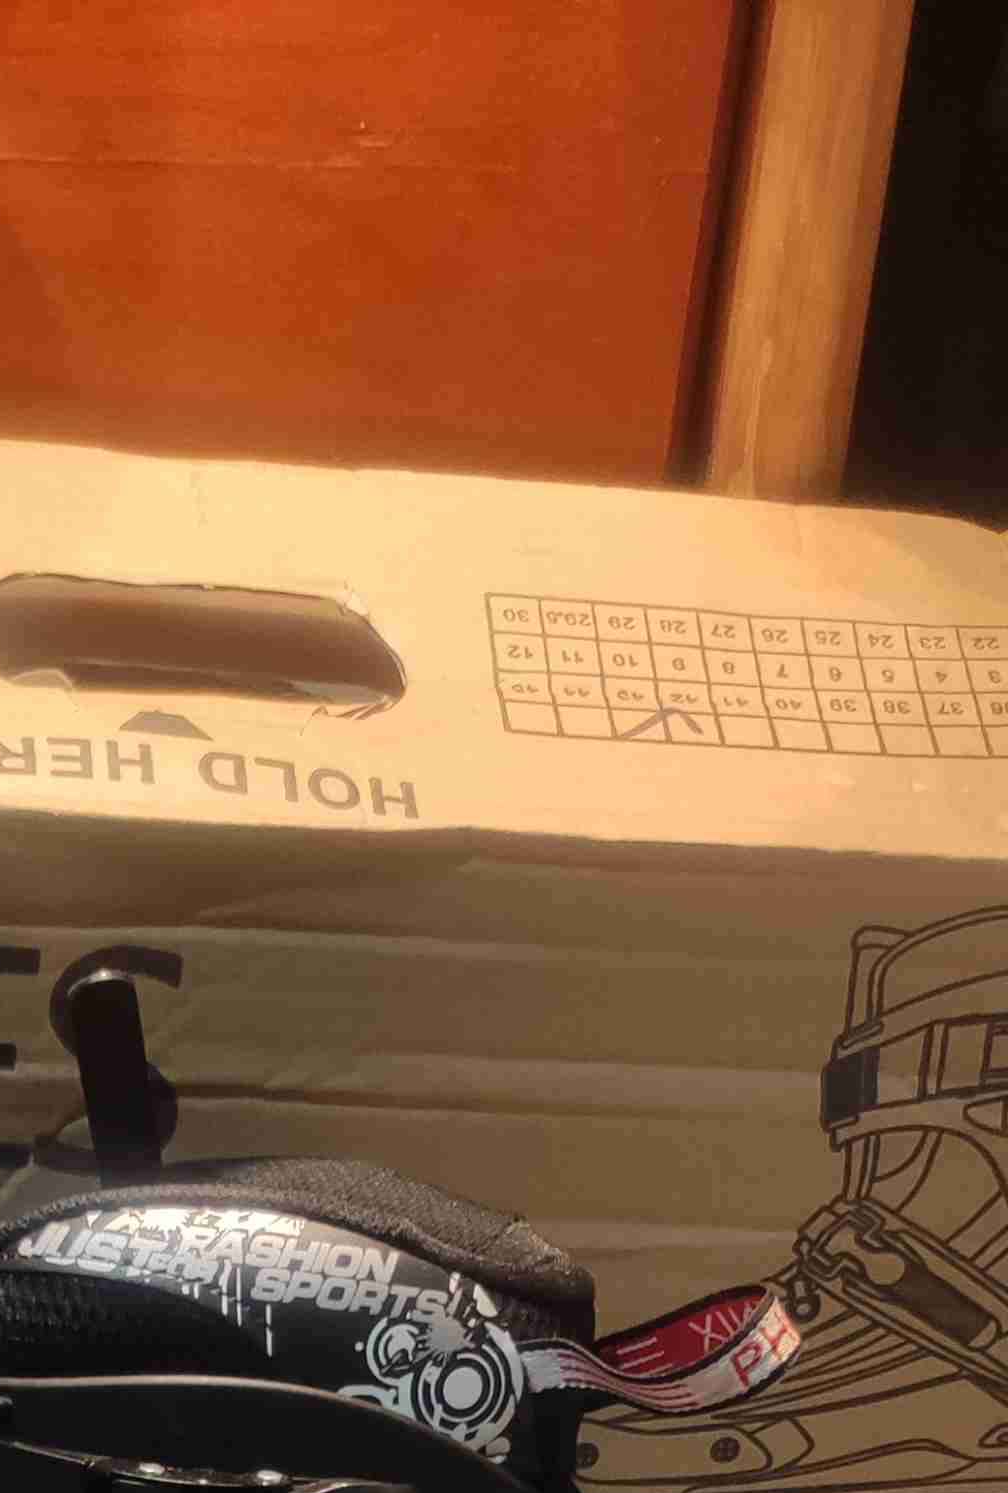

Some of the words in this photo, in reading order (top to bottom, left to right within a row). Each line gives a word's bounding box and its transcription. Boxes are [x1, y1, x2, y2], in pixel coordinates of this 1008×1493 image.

[776, 663, 789, 679] 7
[935, 668, 949, 684] 4
[938, 700, 965, 716] 37
[198, 751, 419, 820] HOLD
